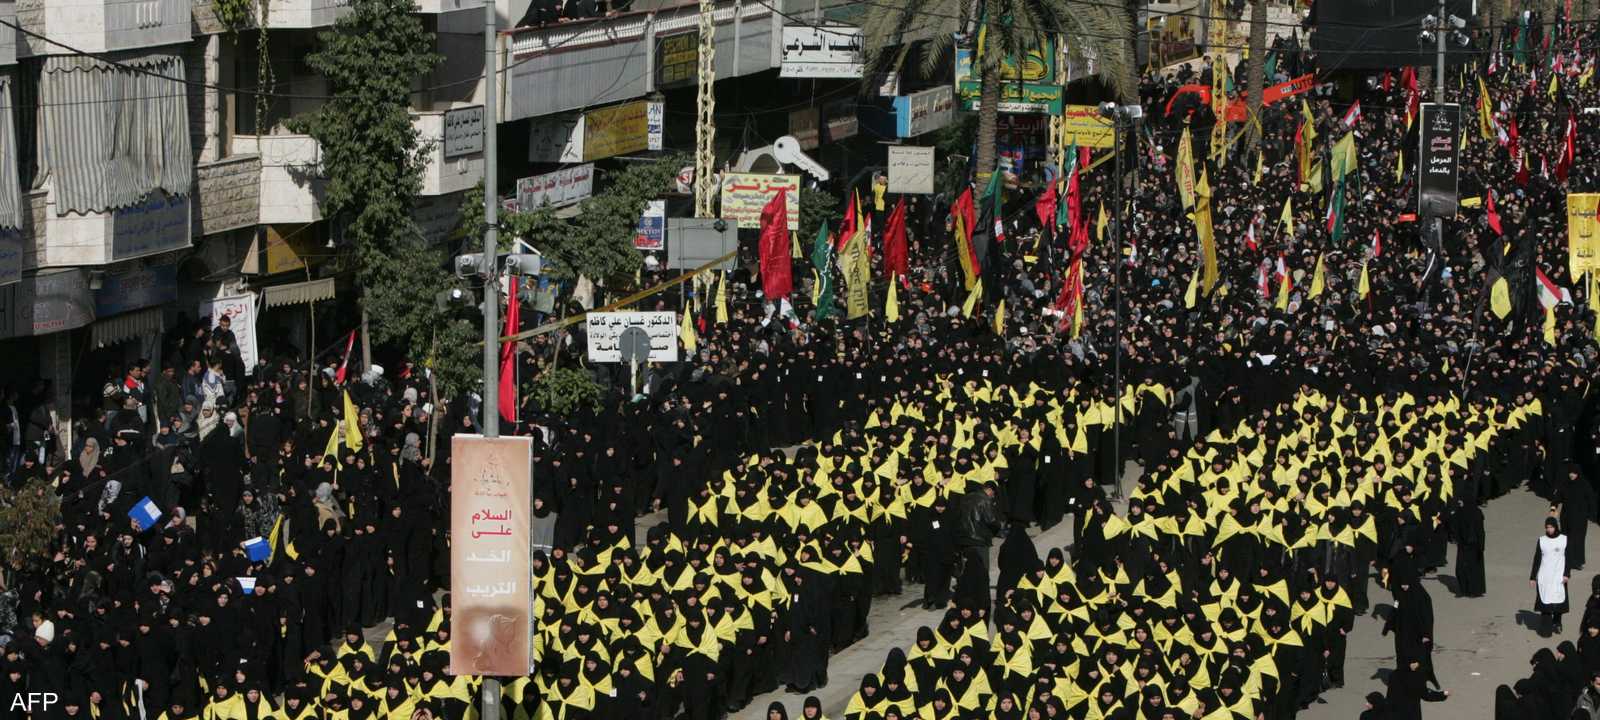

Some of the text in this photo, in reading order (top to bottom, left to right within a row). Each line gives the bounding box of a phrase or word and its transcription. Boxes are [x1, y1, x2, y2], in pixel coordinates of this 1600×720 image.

[783, 33, 826, 60] الشرعي
[590, 314, 673, 330] الدكتور غسان علي كاظم
[594, 341, 621, 351] امة
[472, 509, 513, 525] السلام
[472, 525, 513, 539] على
[467, 549, 513, 564] الخد
[467, 581, 517, 599] التريب
